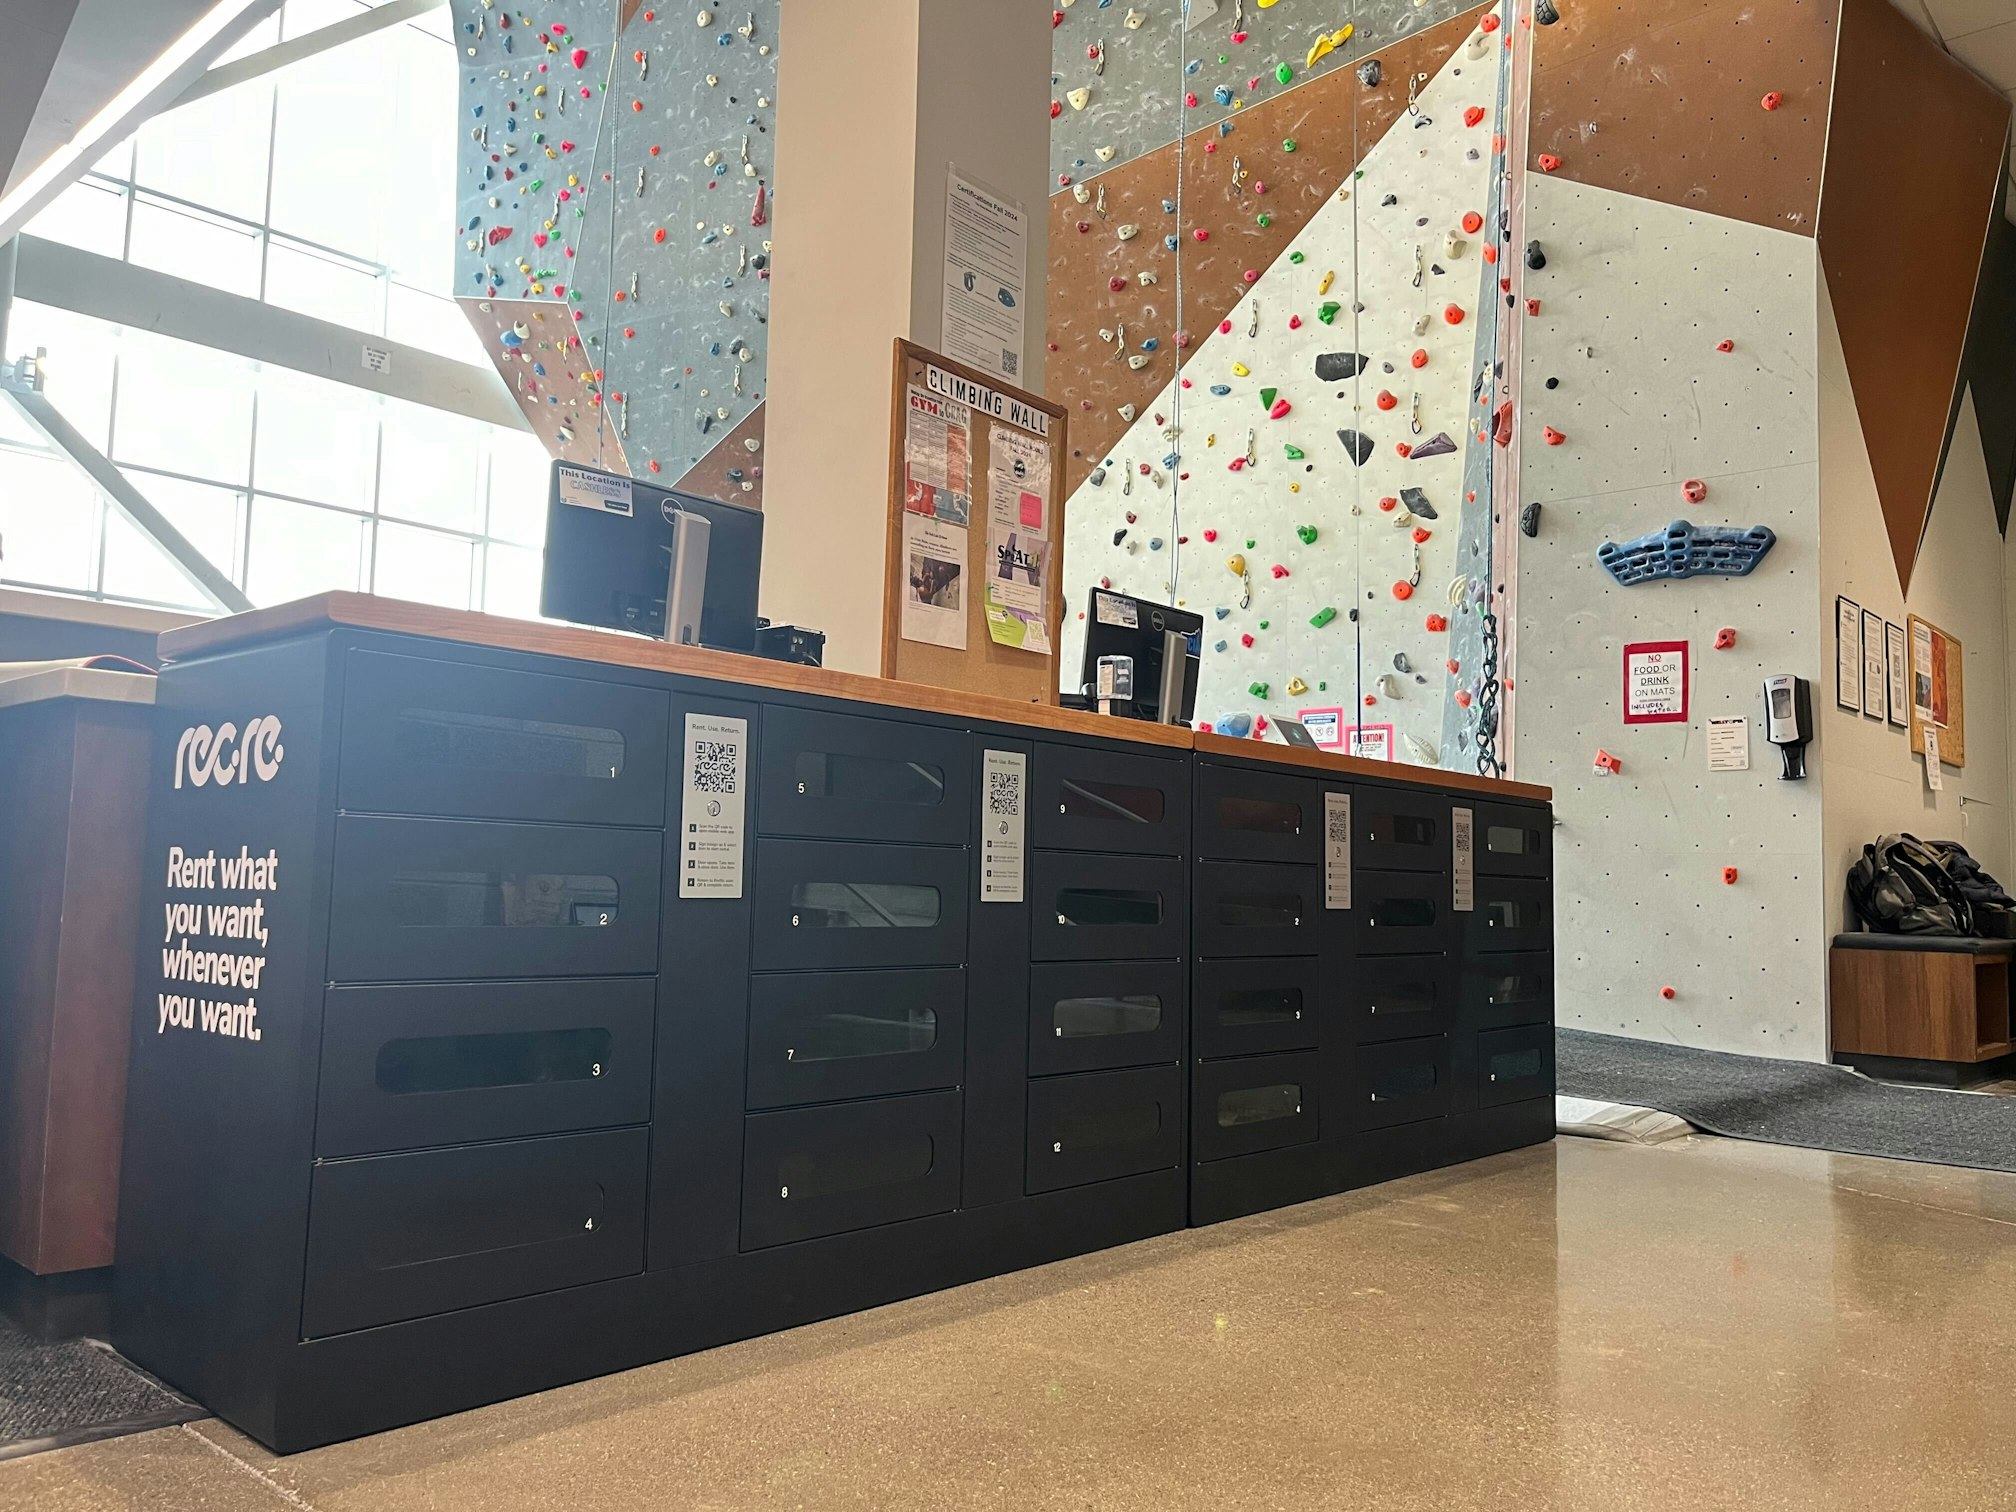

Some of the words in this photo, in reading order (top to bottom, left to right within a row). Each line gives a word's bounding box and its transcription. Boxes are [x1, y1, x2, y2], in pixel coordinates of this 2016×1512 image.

[957, 184, 992, 208] Certifications
[993, 203, 1004, 213] Fall
[1004, 209, 1018, 221] 2024
[911, 396, 938, 415] GYM
[930, 369, 1002, 415] CLIMBING
[1011, 402, 1046, 434] WALL
[560, 469, 579, 478] This
[581, 472, 621, 487] Location
[570, 480, 622, 498] CASHLESS
[1648, 654, 1662, 662] NO
[1634, 665, 1660, 674] FOOD
[1662, 664, 1676, 672] OR
[1641, 676, 1669, 686] DRINK
[1635, 689, 1648, 697] ON
[1650, 687, 1676, 696] MATS
[692, 723, 706, 731] Rent.
[721, 726, 740, 734] Return.
[1353, 733, 1385, 743] AENTION!
[610, 766, 615, 778] 1
[798, 782, 805, 794] 5
[1060, 804, 1066, 814] 9
[167, 846, 217, 889] Rent
[220, 845, 279, 891] what
[165, 903, 203, 943] you
[207, 898, 269, 949] want,
[599, 913, 608, 925] 2
[792, 915, 799, 927] 6
[1057, 914, 1066, 925] 10
[1294, 917, 1300, 926] 2
[162, 938, 266, 990] whenever
[158, 993, 196, 1034] you
[200, 997, 262, 1041] want.
[1295, 1010, 1301, 1019] 3
[1055, 1027, 1062, 1037] 11
[787, 1049, 795, 1061] 7
[592, 1063, 601, 1076] 3
[1053, 1142, 1061, 1153] 12
[781, 1186, 788, 1198] 8
[584, 1218, 593, 1231] 4
